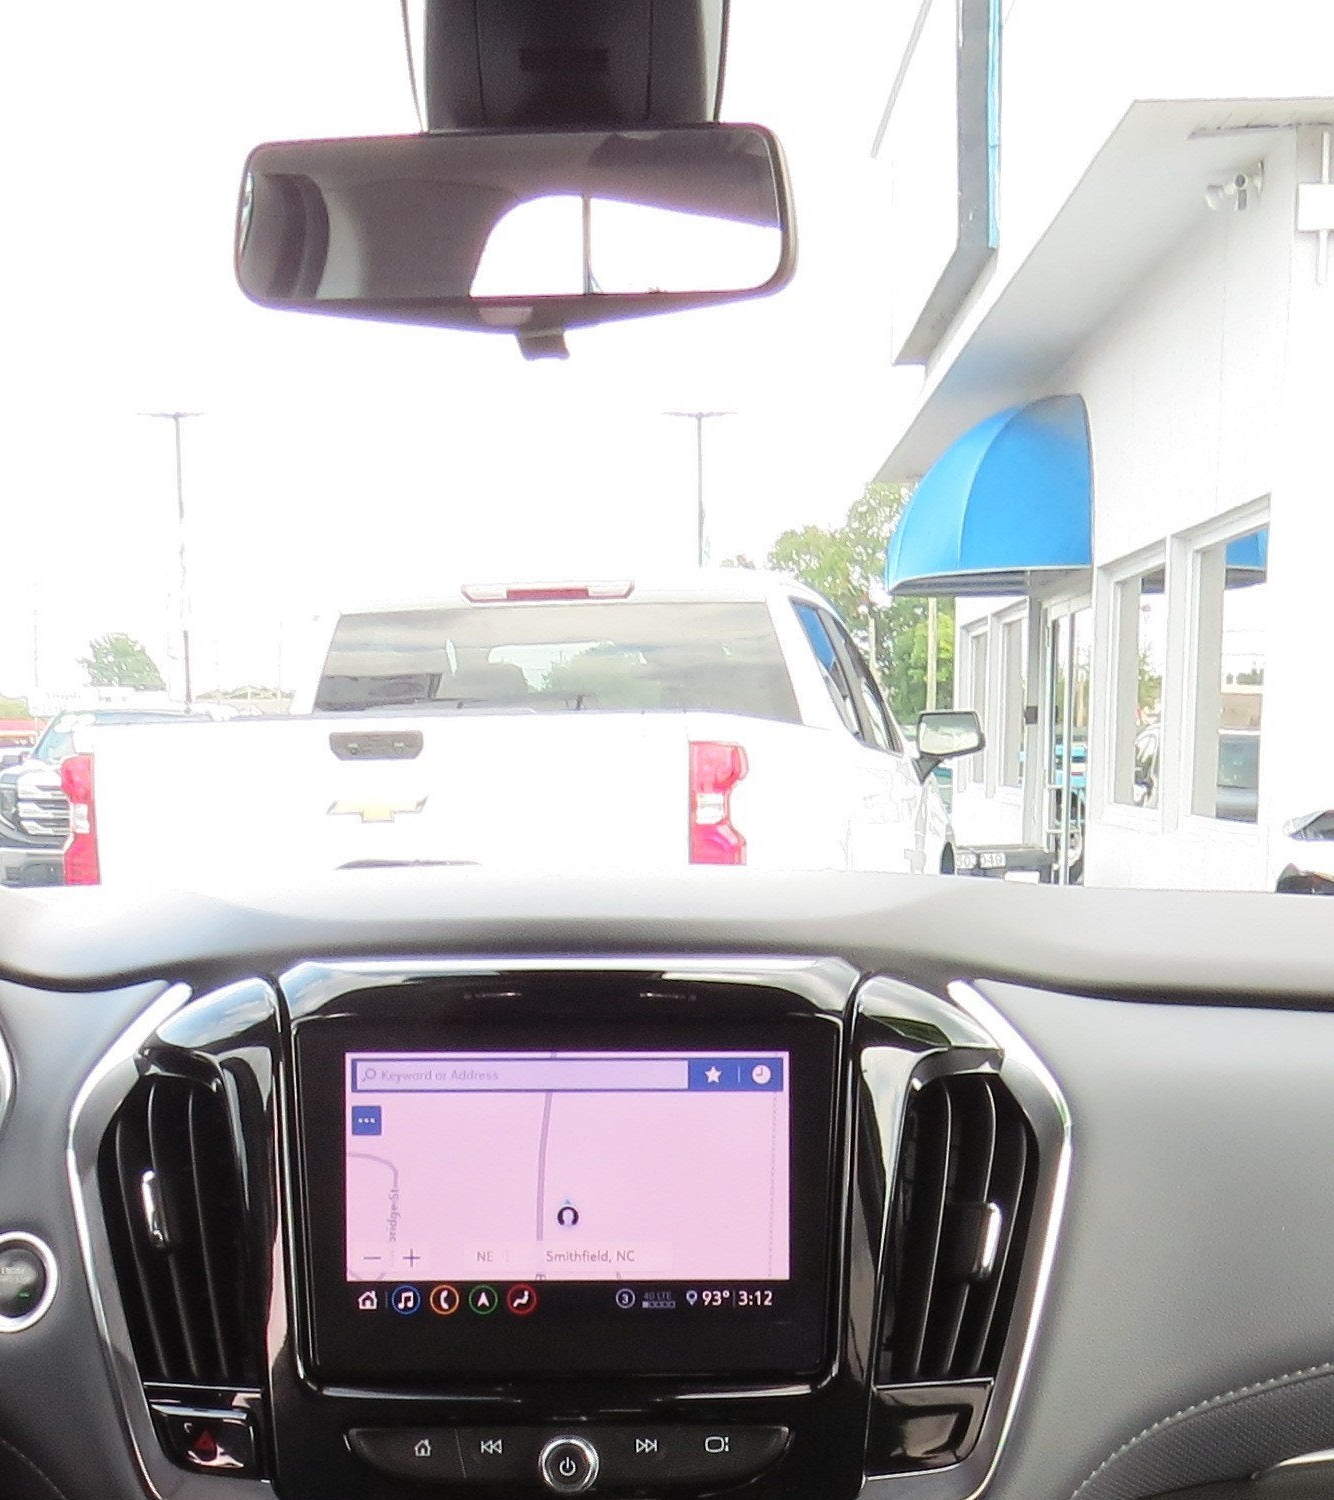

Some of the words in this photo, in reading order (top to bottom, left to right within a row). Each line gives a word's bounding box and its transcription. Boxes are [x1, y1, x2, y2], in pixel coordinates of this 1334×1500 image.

[381, 1069, 432, 1084] Keyword
[435, 1072, 447, 1081] or
[451, 1069, 499, 1081] Address
[476, 1250, 494, 1262] NE
[546, 1249, 612, 1264] Smithfield,
[616, 1250, 636, 1262] NC
[737, 1290, 774, 1306] 3:12
